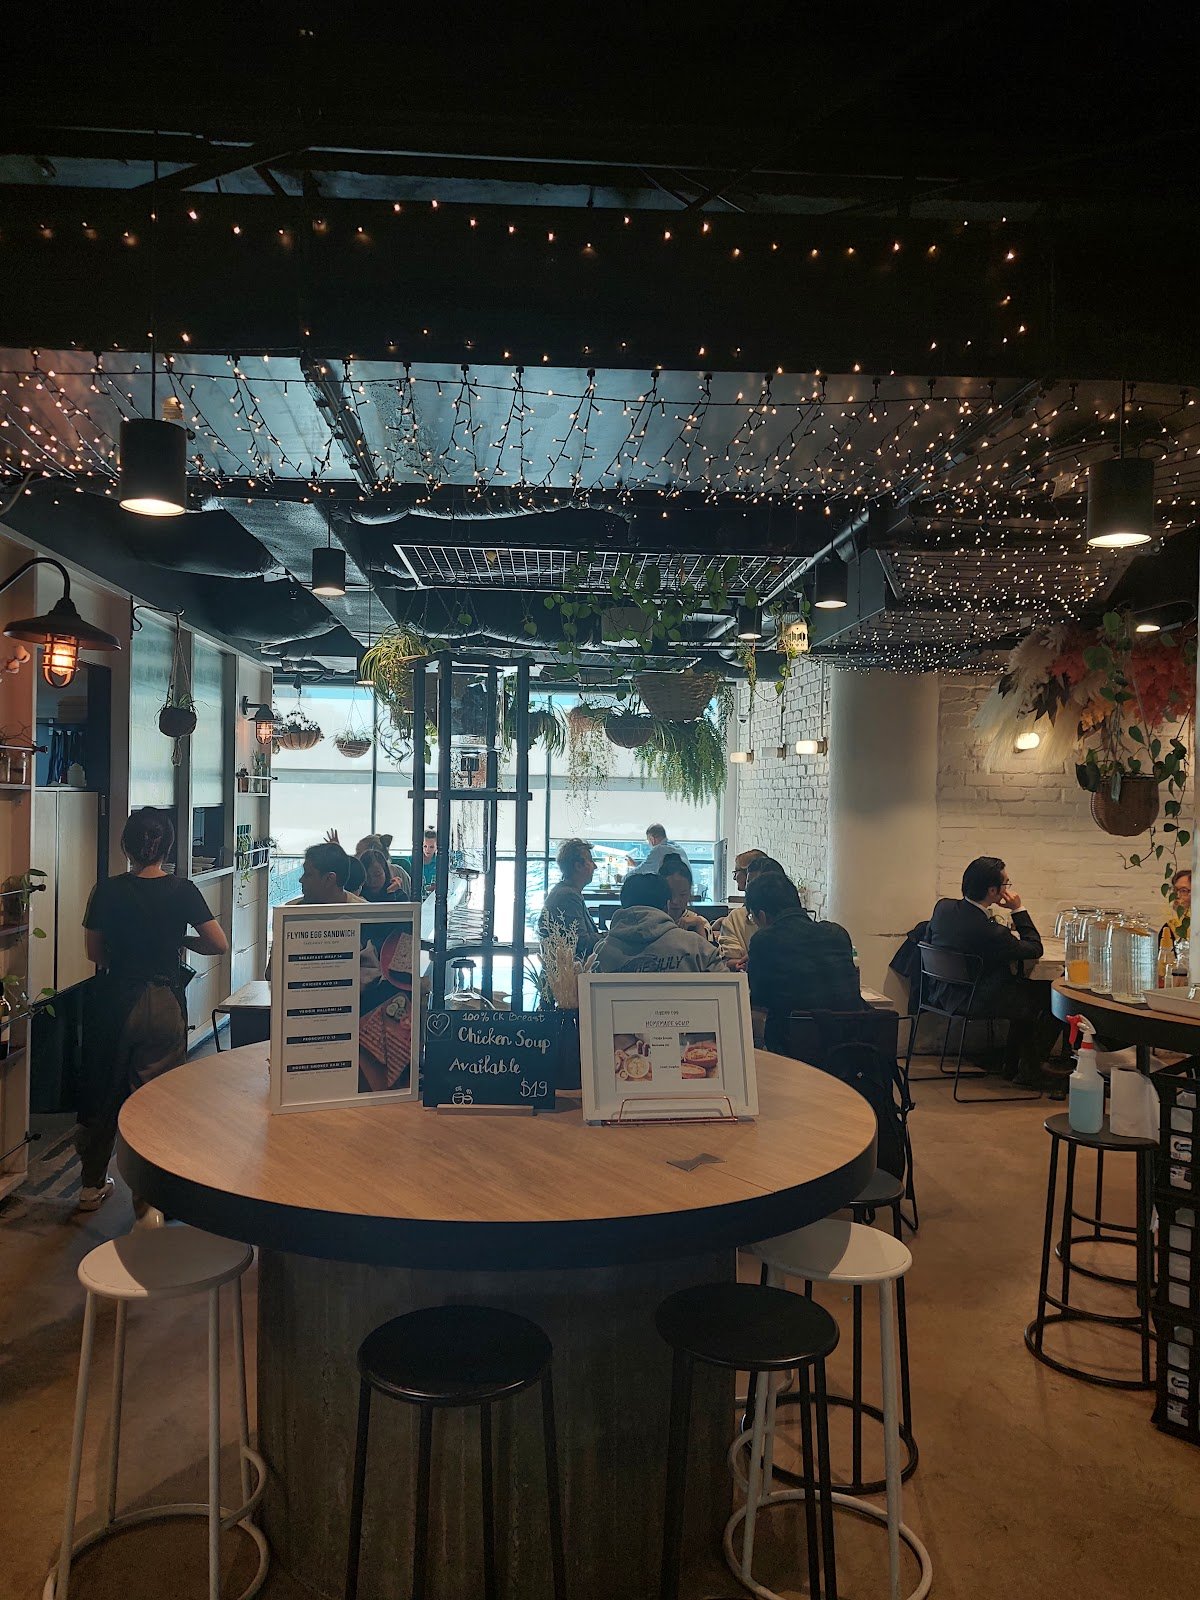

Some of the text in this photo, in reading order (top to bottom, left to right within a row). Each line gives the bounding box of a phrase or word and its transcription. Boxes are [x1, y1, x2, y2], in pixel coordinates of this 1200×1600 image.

[287, 929, 356, 940] FLYING EGG SANDWICH
[462, 1012, 490, 1022] 100%
[492, 1013, 505, 1021] CK
[458, 1026, 551, 1054] Chicken Soup
[448, 1054, 521, 1075] Available
[520, 1078, 548, 1098] $19
